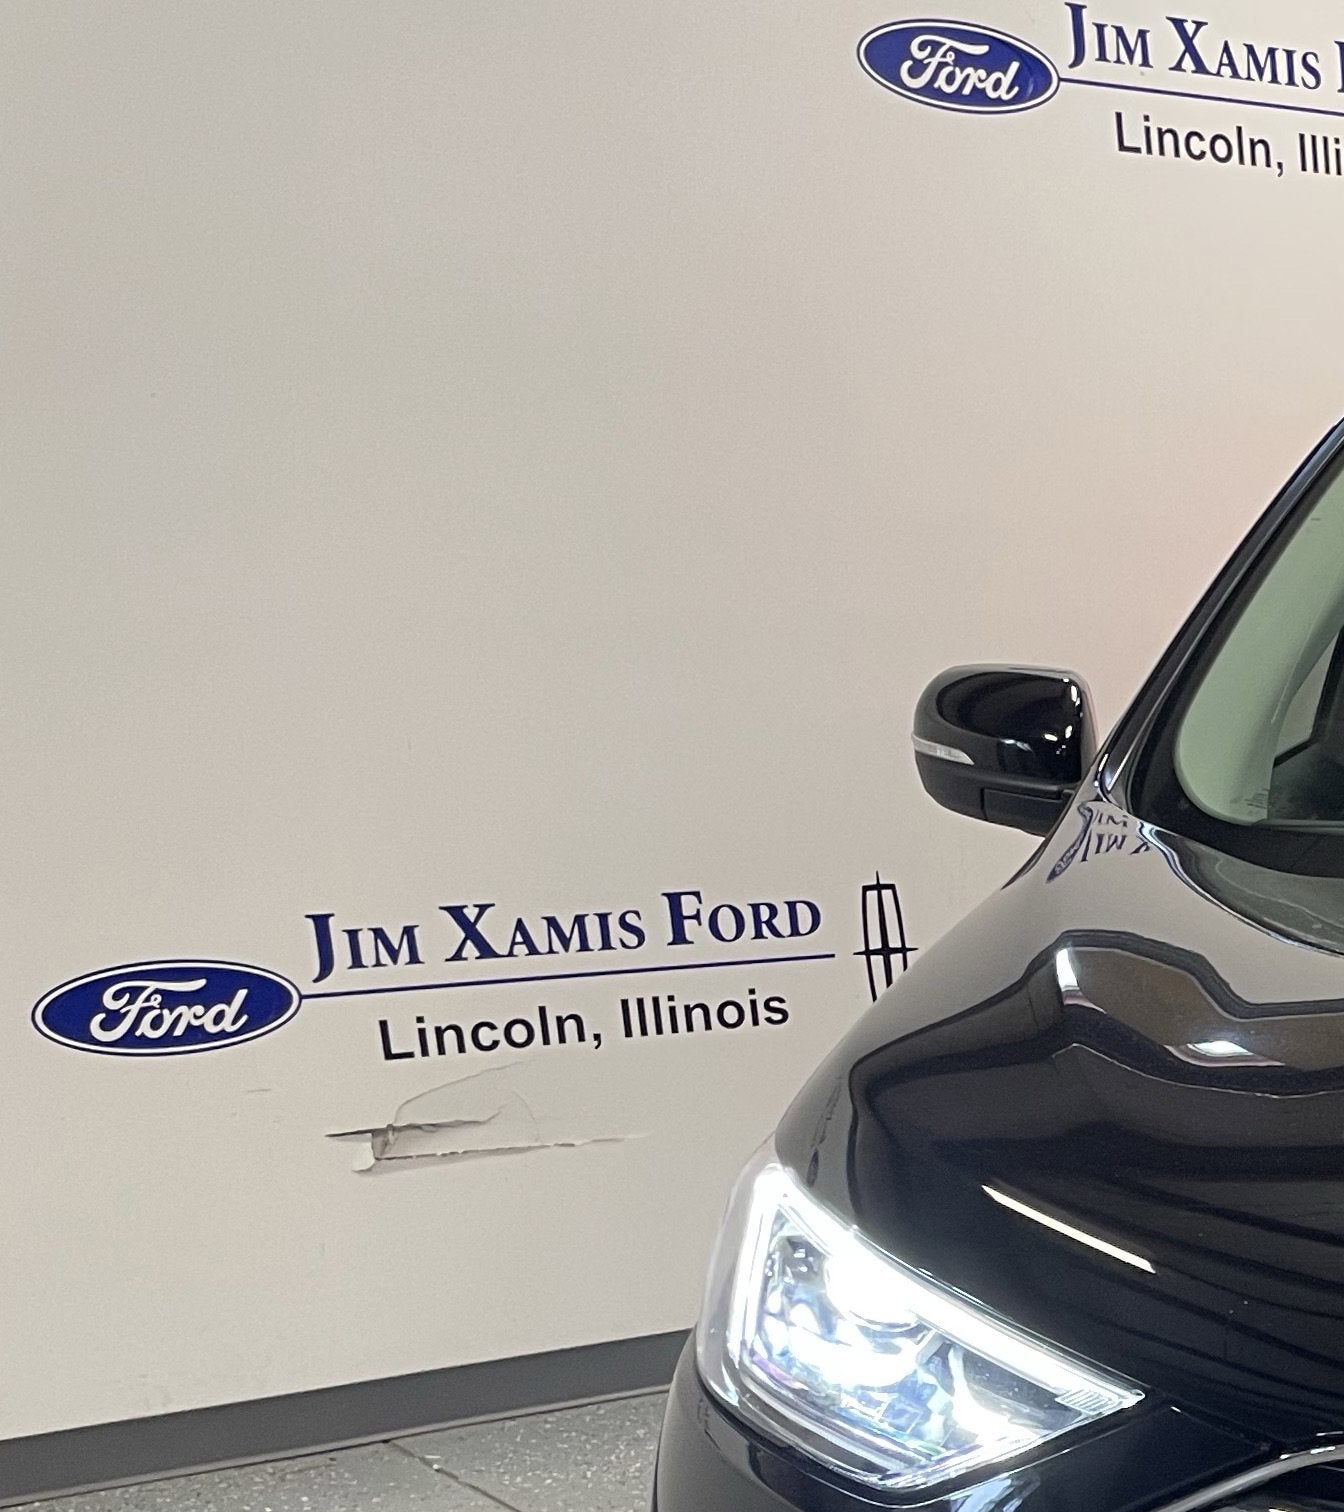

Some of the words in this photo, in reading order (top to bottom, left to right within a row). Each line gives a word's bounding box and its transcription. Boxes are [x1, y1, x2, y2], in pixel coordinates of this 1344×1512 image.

[900, 34, 1019, 101] Ford
[1063, 2, 1153, 70] JIM
[1166, 16, 1322, 91] XAMIS
[1114, 112, 1284, 178] Lincoln,
[305, 911, 420, 983] JIM
[439, 902, 645, 964] XAMIS
[660, 890, 823, 947] FORD
[90, 979, 248, 1043] Ford
[377, 1005, 602, 1061] Lincoln,
[621, 989, 790, 1039] Illinois
